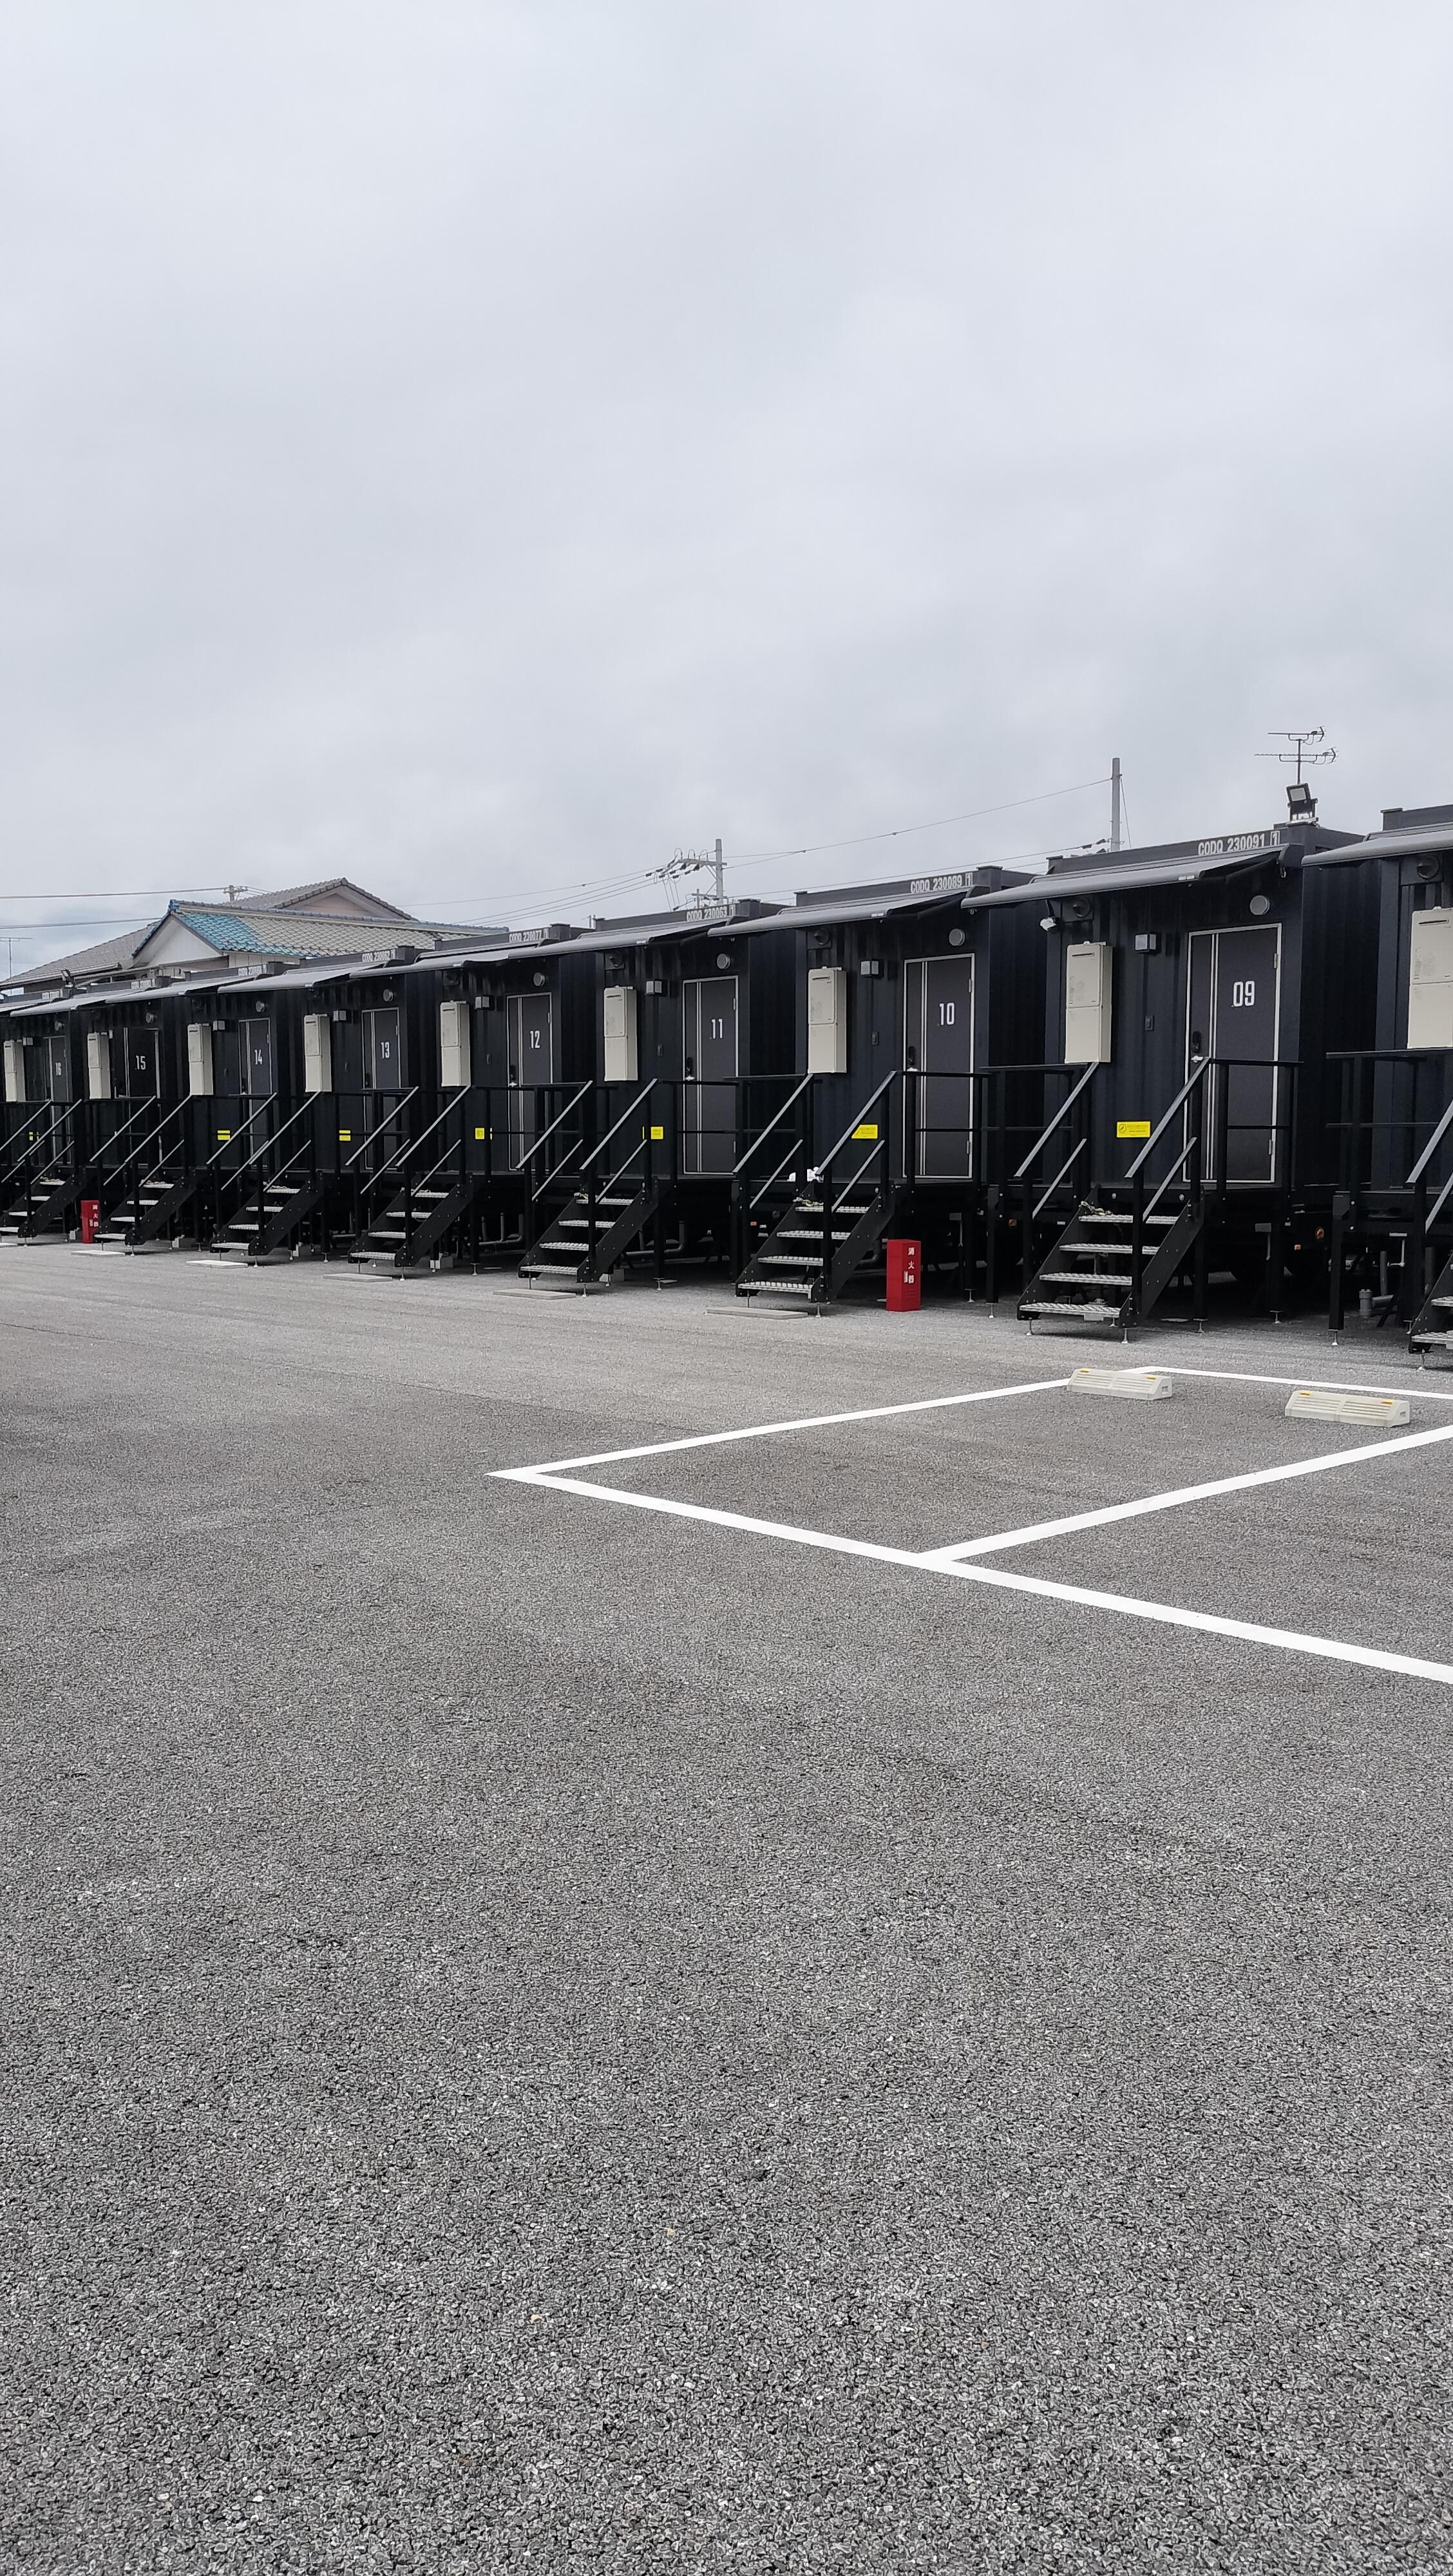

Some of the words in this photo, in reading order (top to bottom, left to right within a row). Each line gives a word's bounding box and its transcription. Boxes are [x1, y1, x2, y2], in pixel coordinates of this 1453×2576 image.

[1227, 833, 1265, 852] 230091
[933, 875, 962, 891] 230089
[1233, 981, 1255, 1007] 09
[940, 1003, 954, 1025] 10
[712, 1019, 723, 1039] 11
[530, 1030, 540, 1048] 12
[254, 1049, 263, 1065] 14
[381, 1041, 390, 1058] 13
[55, 1063, 61, 1075] 16
[136, 1055, 146, 1070] 15
